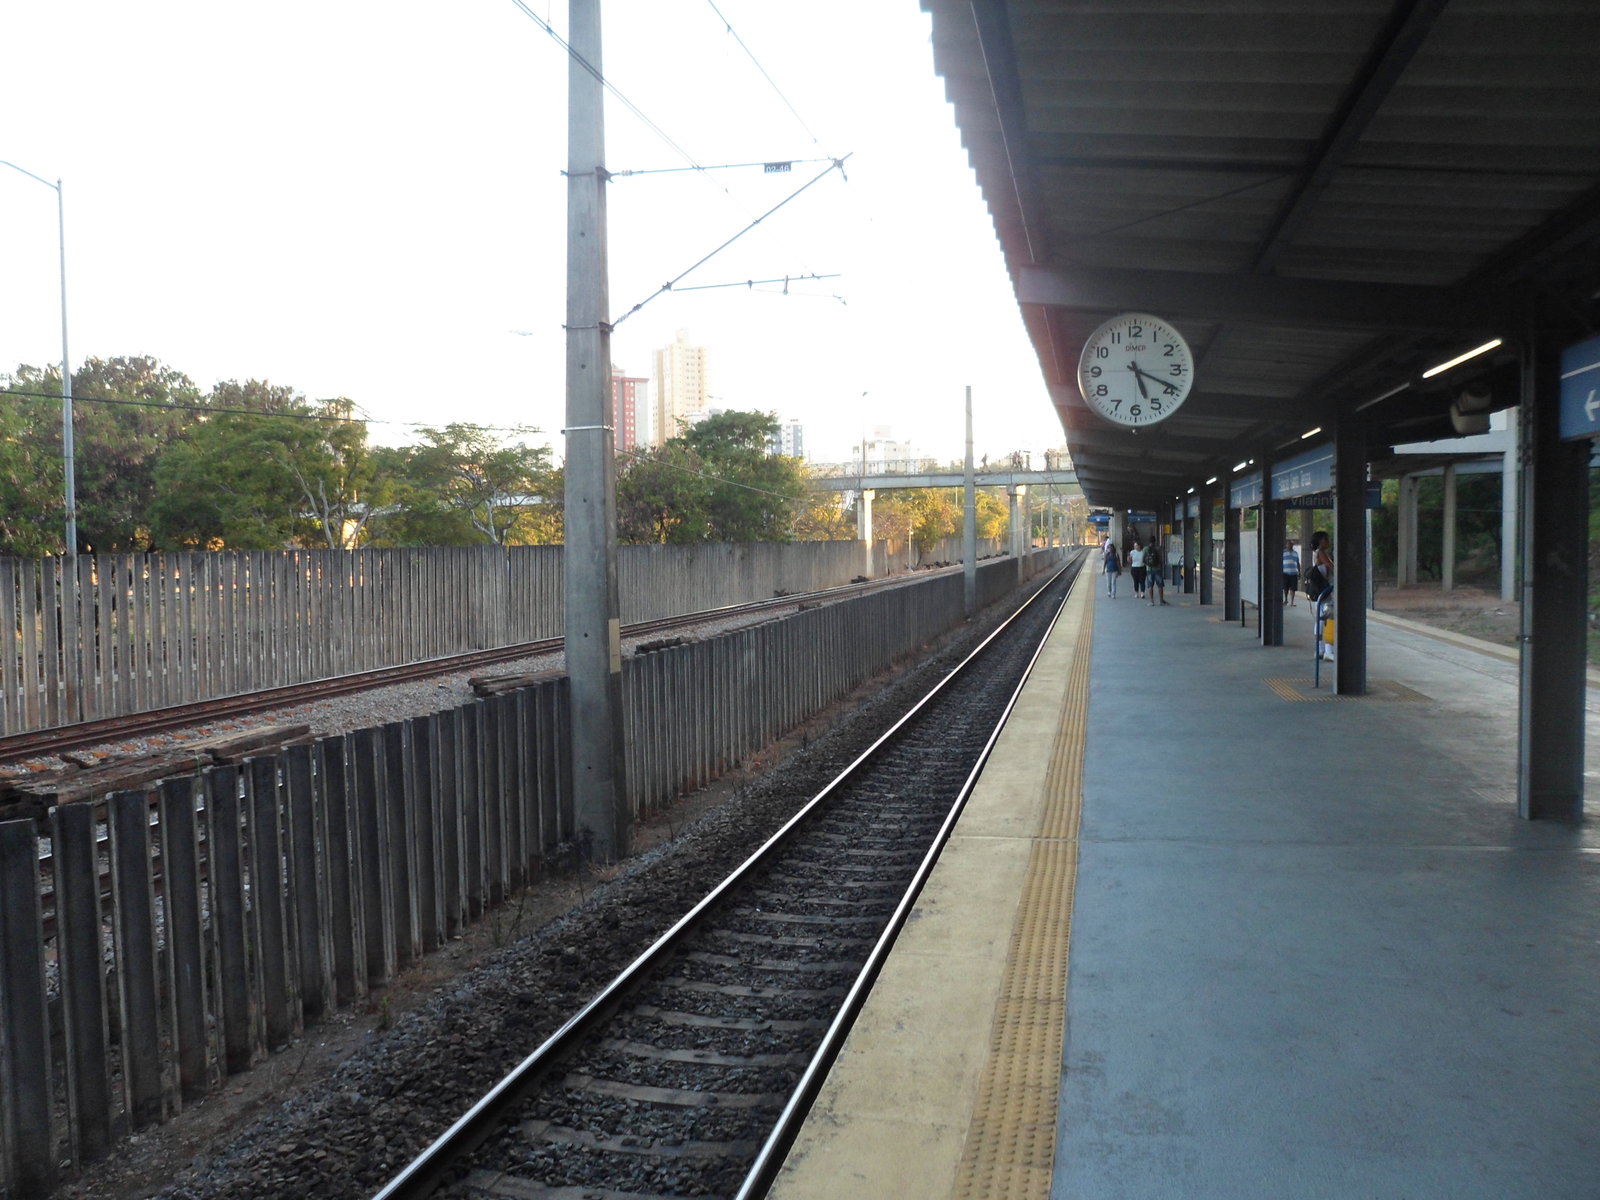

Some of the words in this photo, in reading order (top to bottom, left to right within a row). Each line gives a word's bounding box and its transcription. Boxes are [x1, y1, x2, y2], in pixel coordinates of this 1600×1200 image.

[1111, 332, 1121, 344] 11
[1129, 326, 1142, 338] 12
[1153, 331, 1157, 343] 1
[1096, 347, 1109, 359] 10
[1163, 344, 1174, 357] 2
[1090, 366, 1102, 378] 9
[1169, 364, 1182, 376] 3
[1096, 385, 1108, 397] 8
[1163, 385, 1175, 395] 4
[1110, 399, 1122, 411] 7
[1130, 405, 1142, 416] 6
[1150, 398, 1162, 411] 5
[1291, 495, 1334, 506] Vilarinh
